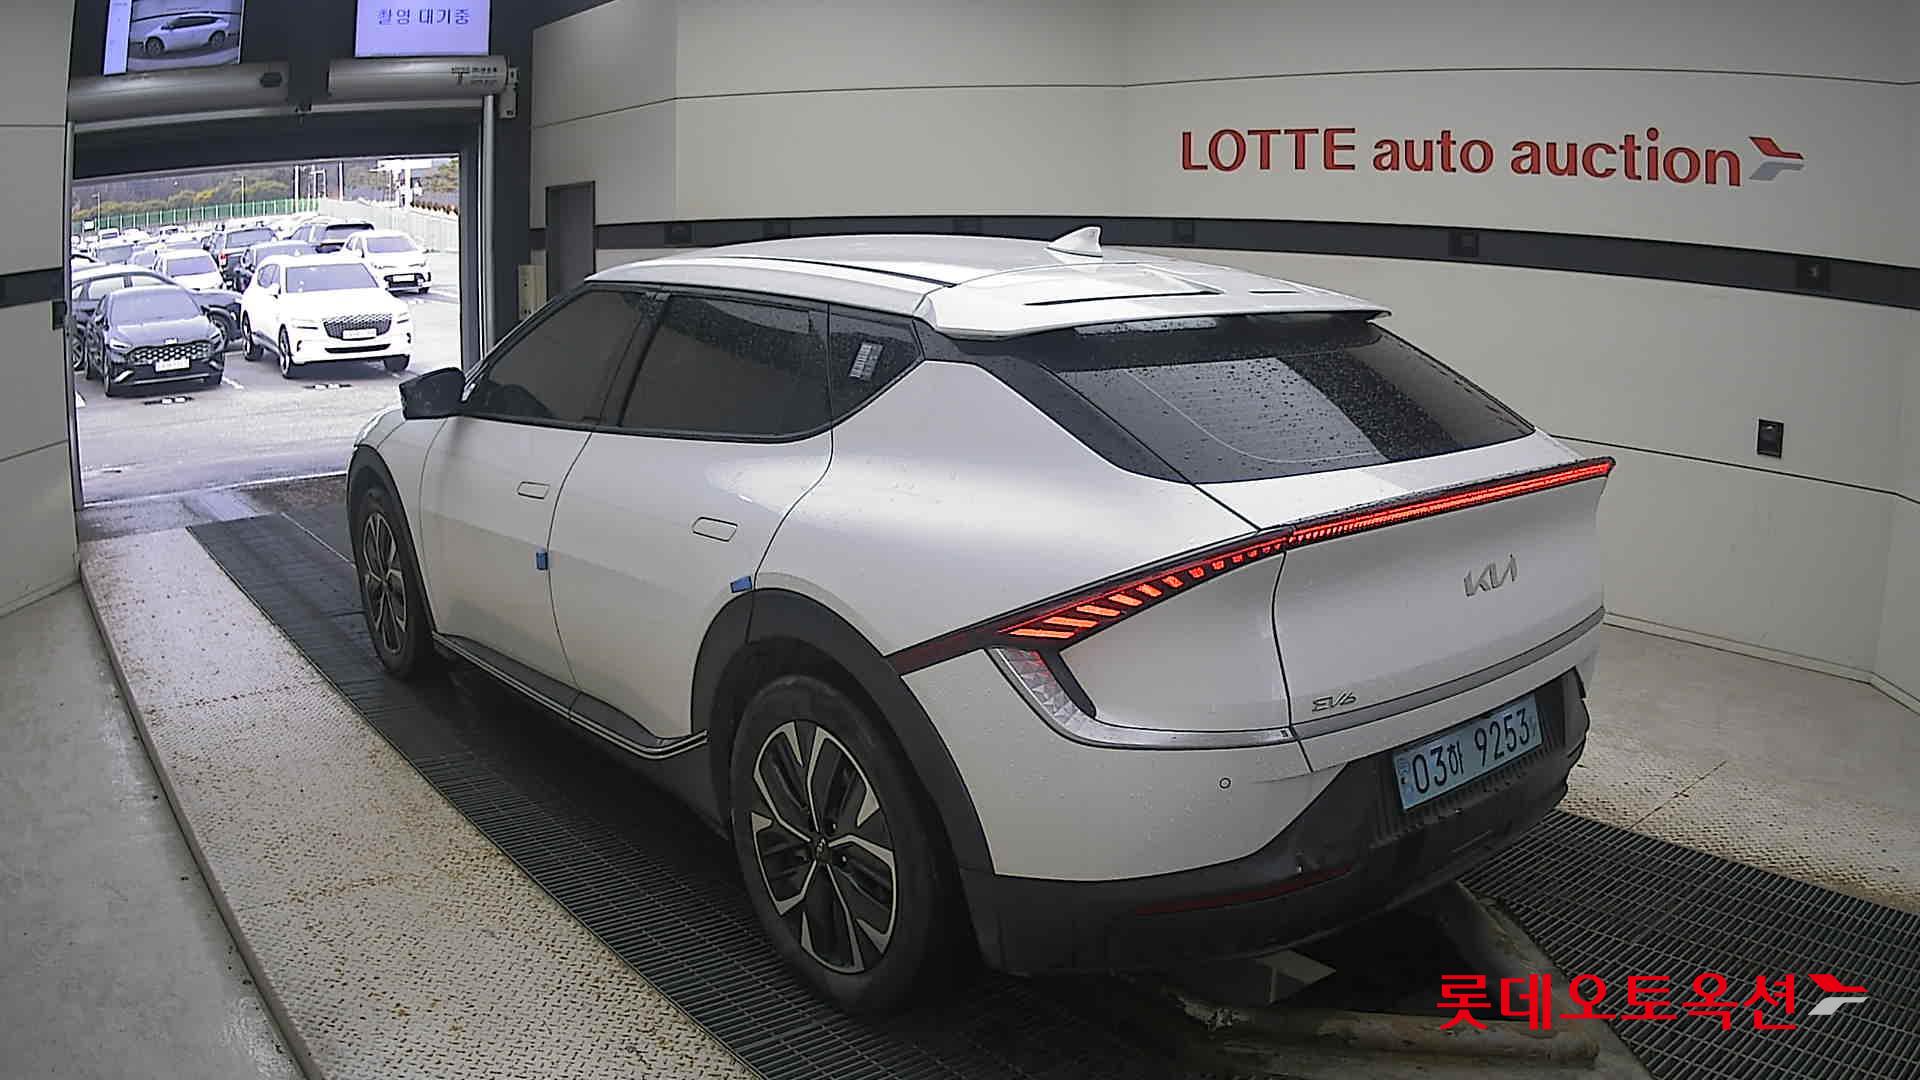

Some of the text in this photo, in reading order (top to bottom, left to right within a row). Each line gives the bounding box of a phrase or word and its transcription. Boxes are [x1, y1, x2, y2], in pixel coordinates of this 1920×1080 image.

[419, 8, 470, 25] 대기중
[1181, 127, 1743, 187] LOTTE auto auction
[1463, 553, 1518, 597] KIA
[1311, 691, 1357, 713] EV6
[1411, 740, 1464, 794] 03하
[1474, 707, 1530, 767] 9253
